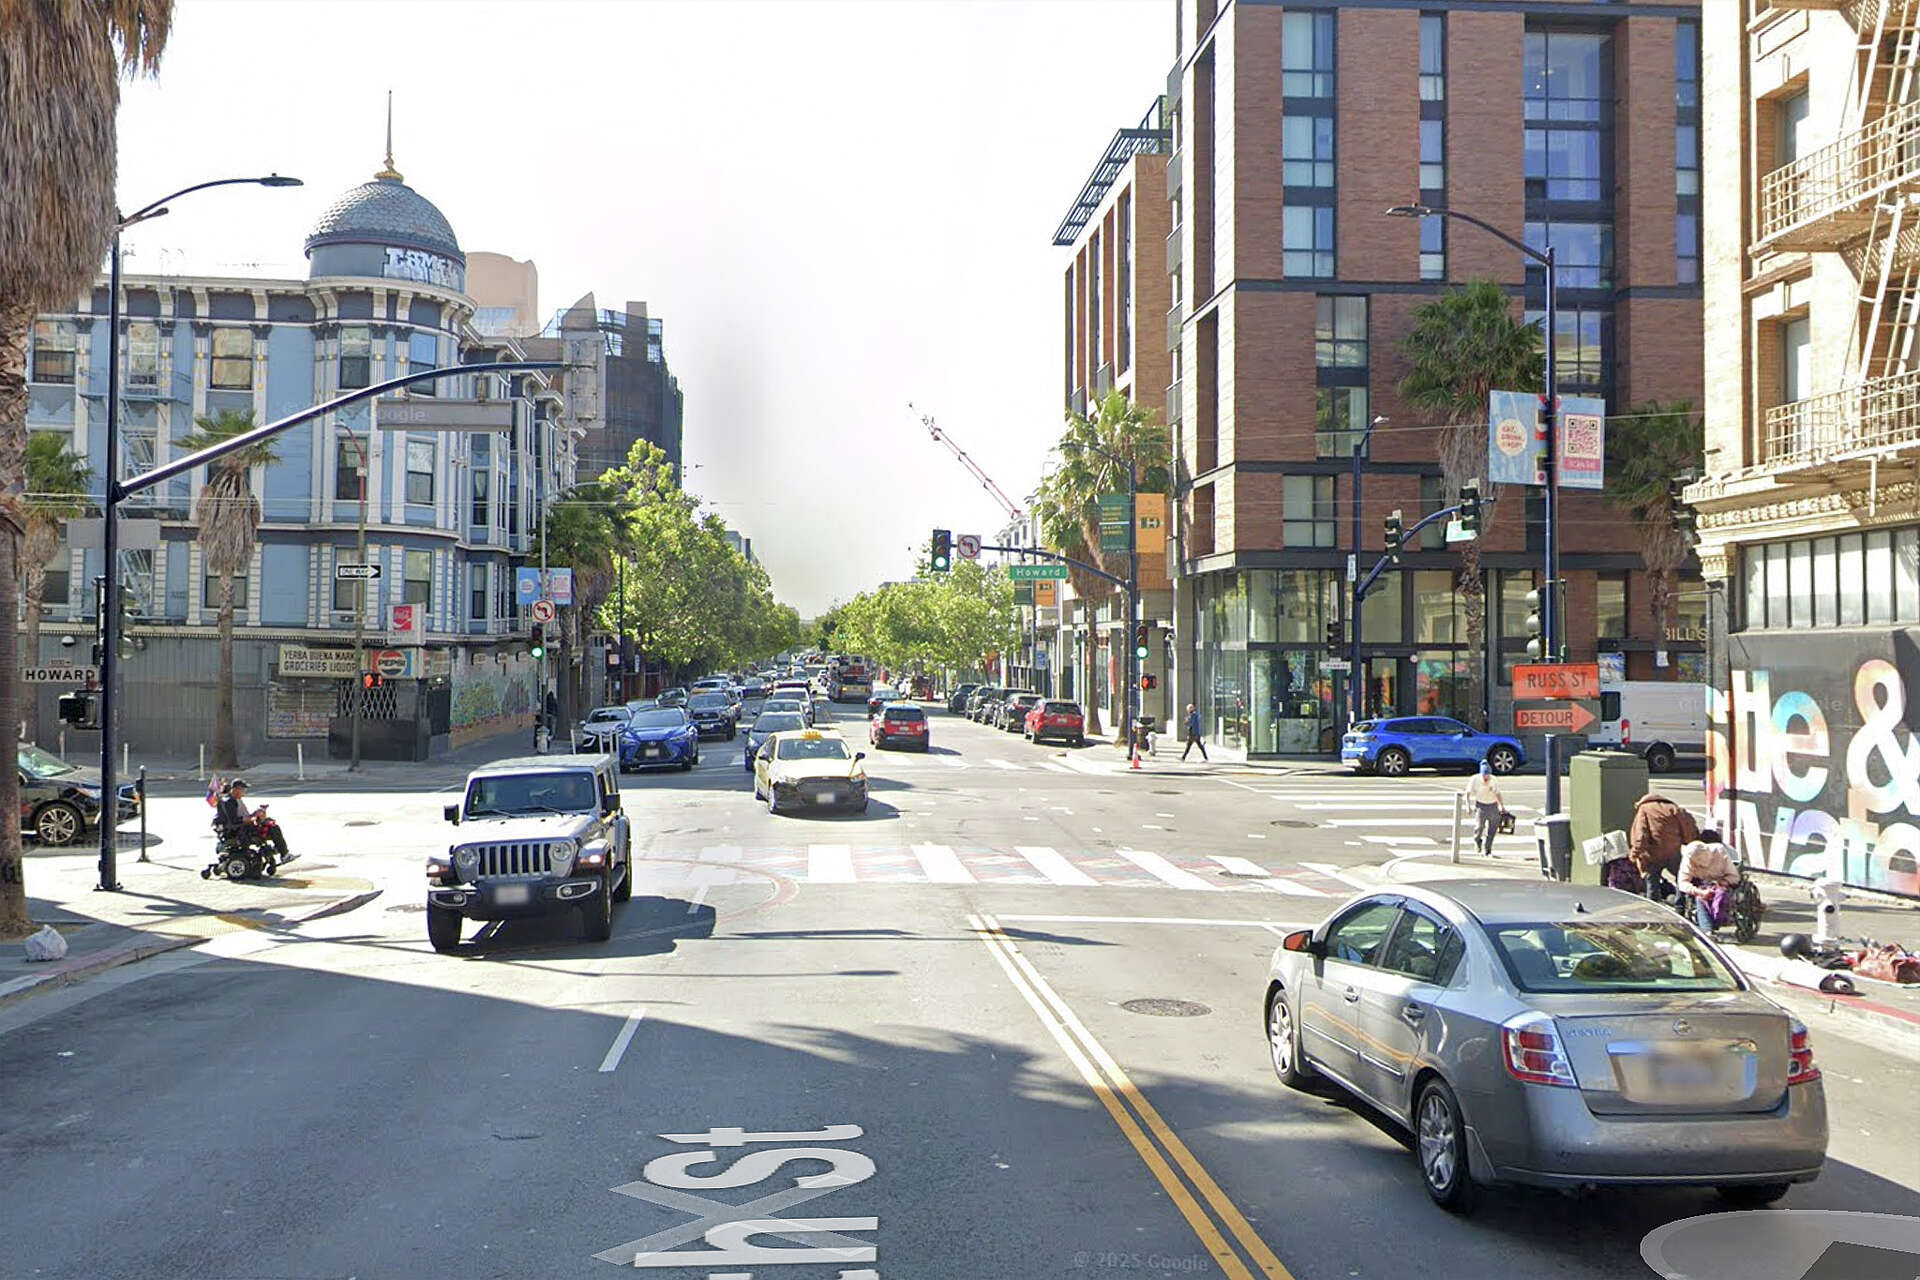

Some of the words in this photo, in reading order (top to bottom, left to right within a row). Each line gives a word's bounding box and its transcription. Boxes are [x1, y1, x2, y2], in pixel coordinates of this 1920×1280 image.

[1016, 567, 1061, 578] Howard
[284, 661, 327, 672] GROCERIES
[378, 658, 406, 667] PEPSI
[25, 669, 96, 682] HOWARD
[1527, 672, 1565, 688] RUSS
[1572, 672, 1588, 688] ST
[1520, 711, 1573, 725] DETOUR
